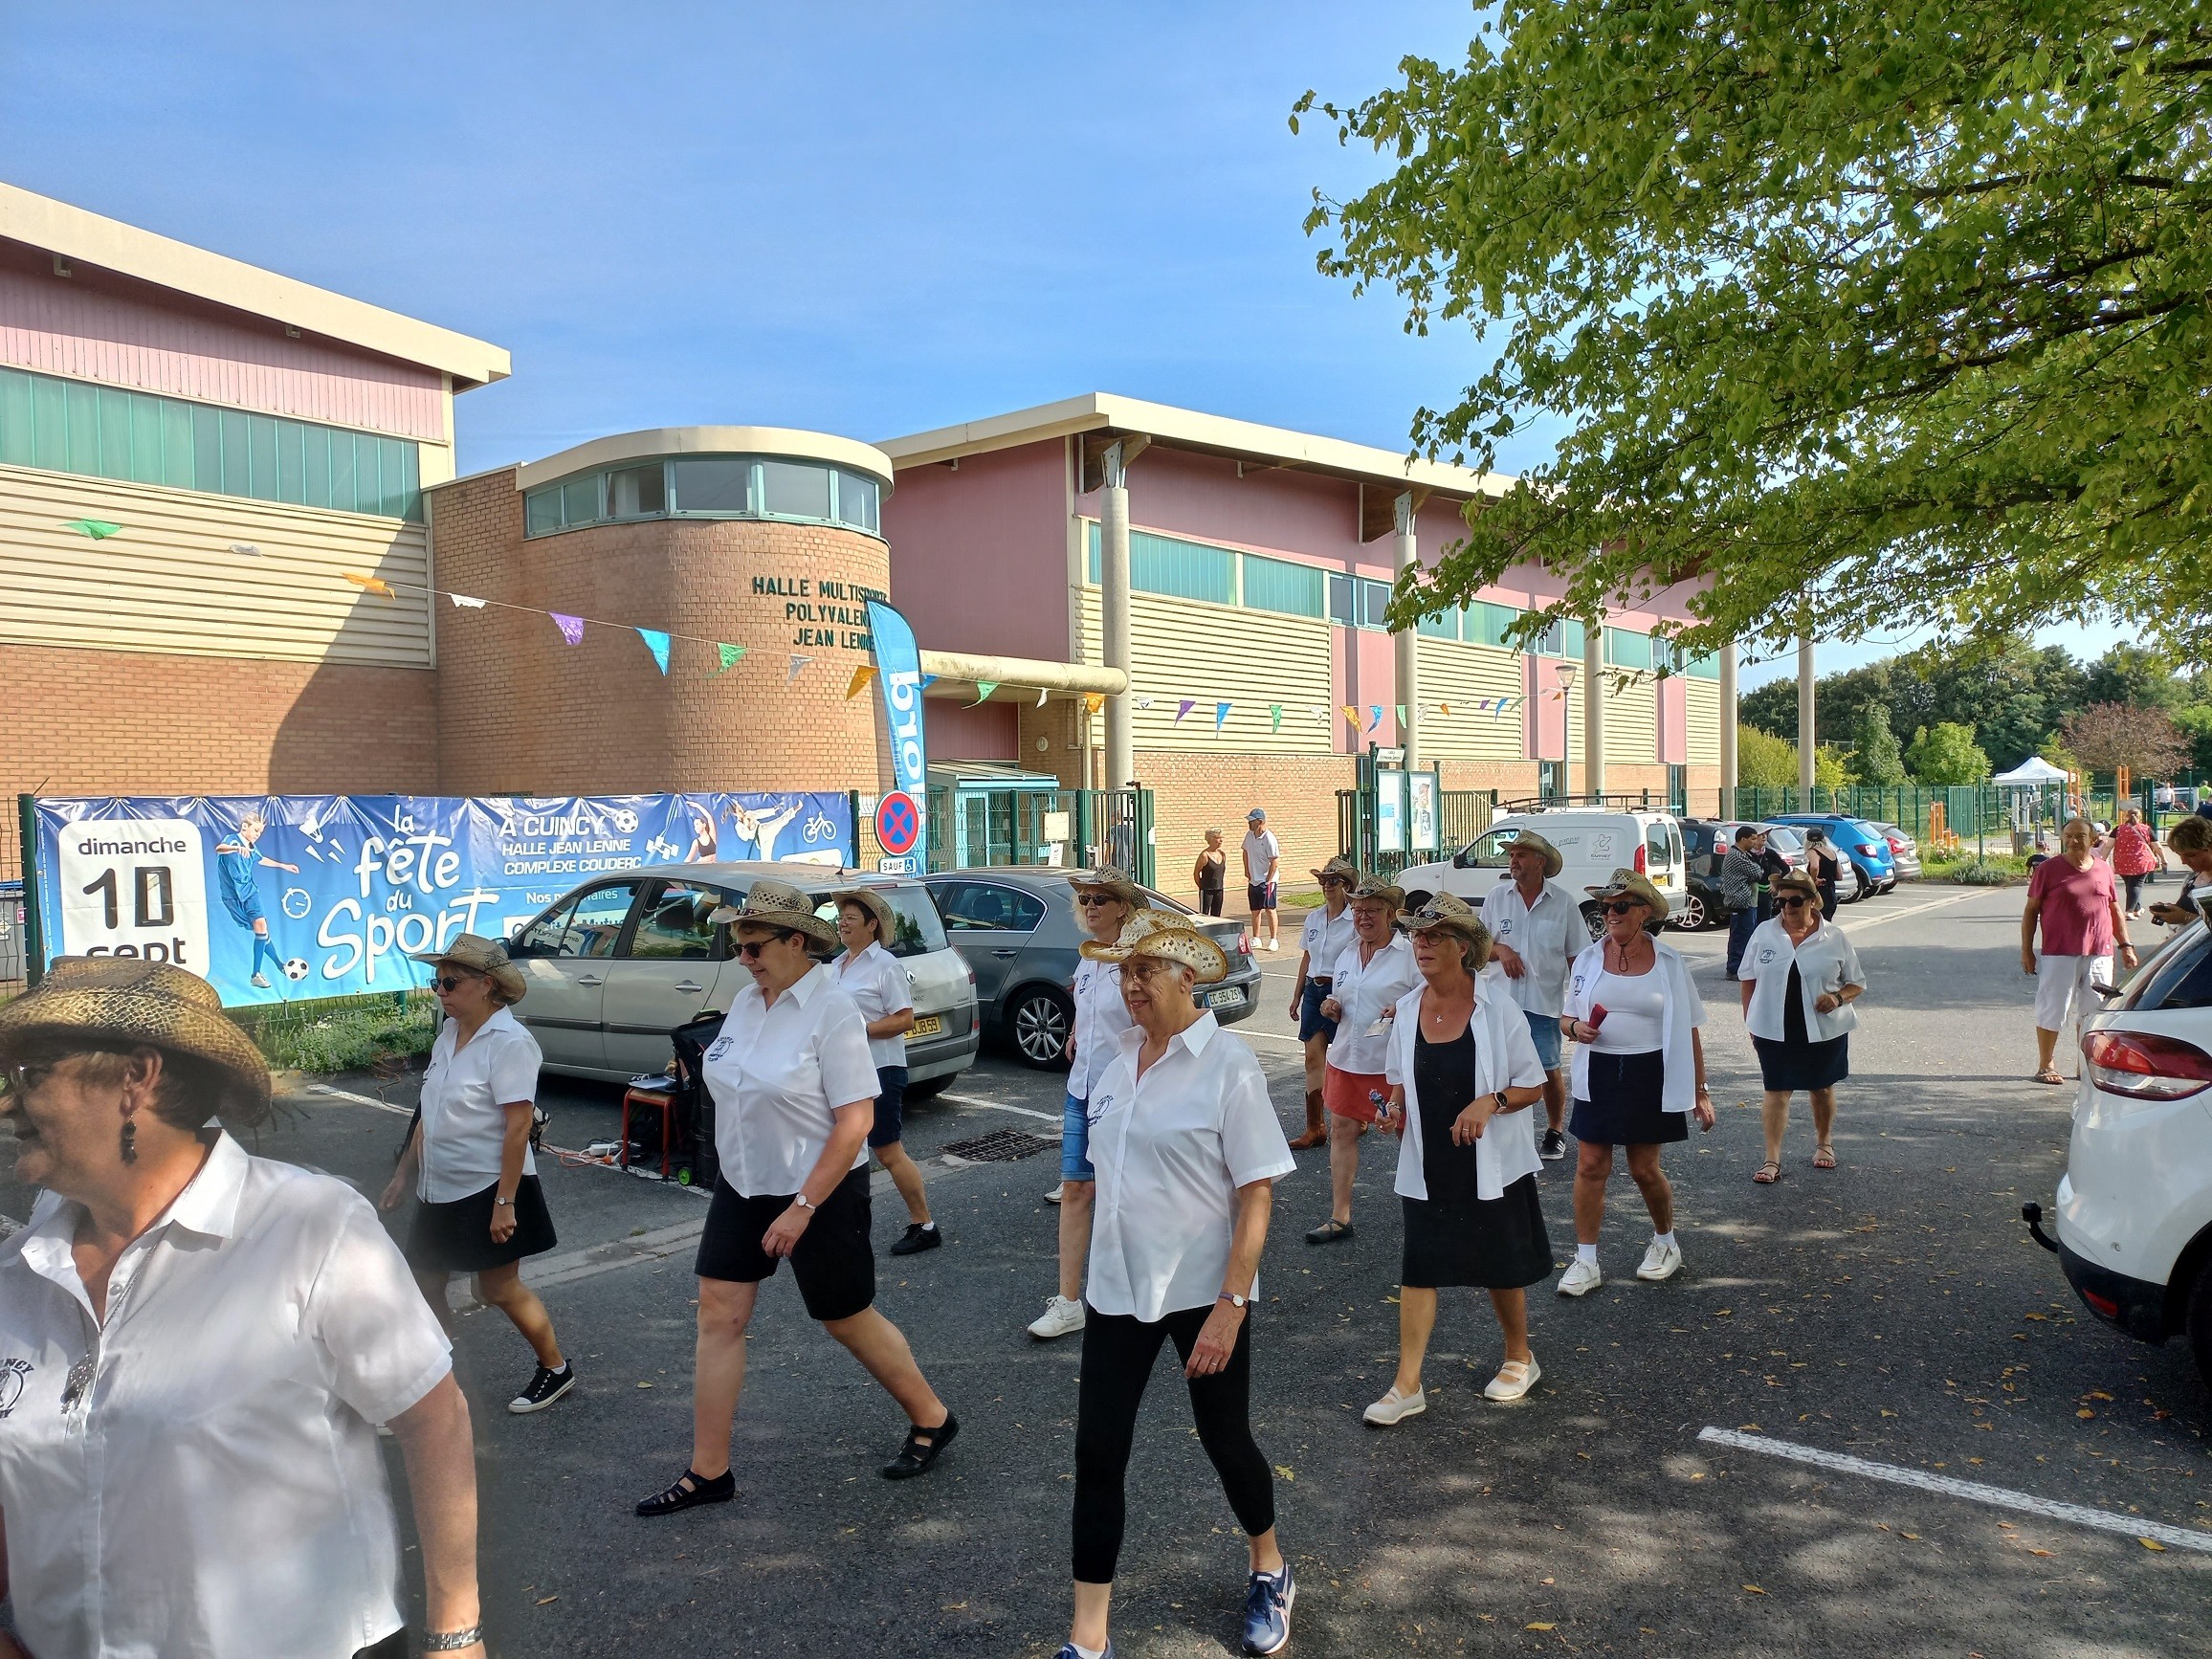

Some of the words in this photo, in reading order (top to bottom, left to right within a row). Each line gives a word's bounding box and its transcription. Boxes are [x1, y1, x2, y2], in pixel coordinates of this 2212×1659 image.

[752, 576, 810, 597] HALLE
[793, 628, 834, 647] JEAN
[394, 804, 415, 832] la
[523, 815, 606, 836] CUINCY
[77, 837, 187, 855] dimanche
[501, 842, 546, 856] HALLE
[548, 841, 583, 855] JEAN
[586, 839, 631, 853] LENNE
[503, 860, 576, 875] COMPLEXE
[579, 856, 642, 872] COUDERC
[883, 861, 903, 871] SAUF
[82, 866, 174, 930] 10
[386, 889, 412, 912] du
[526, 892, 552, 904] Nos
[317, 887, 500, 984] Sport
[926, 1019, 939, 1031] 59
